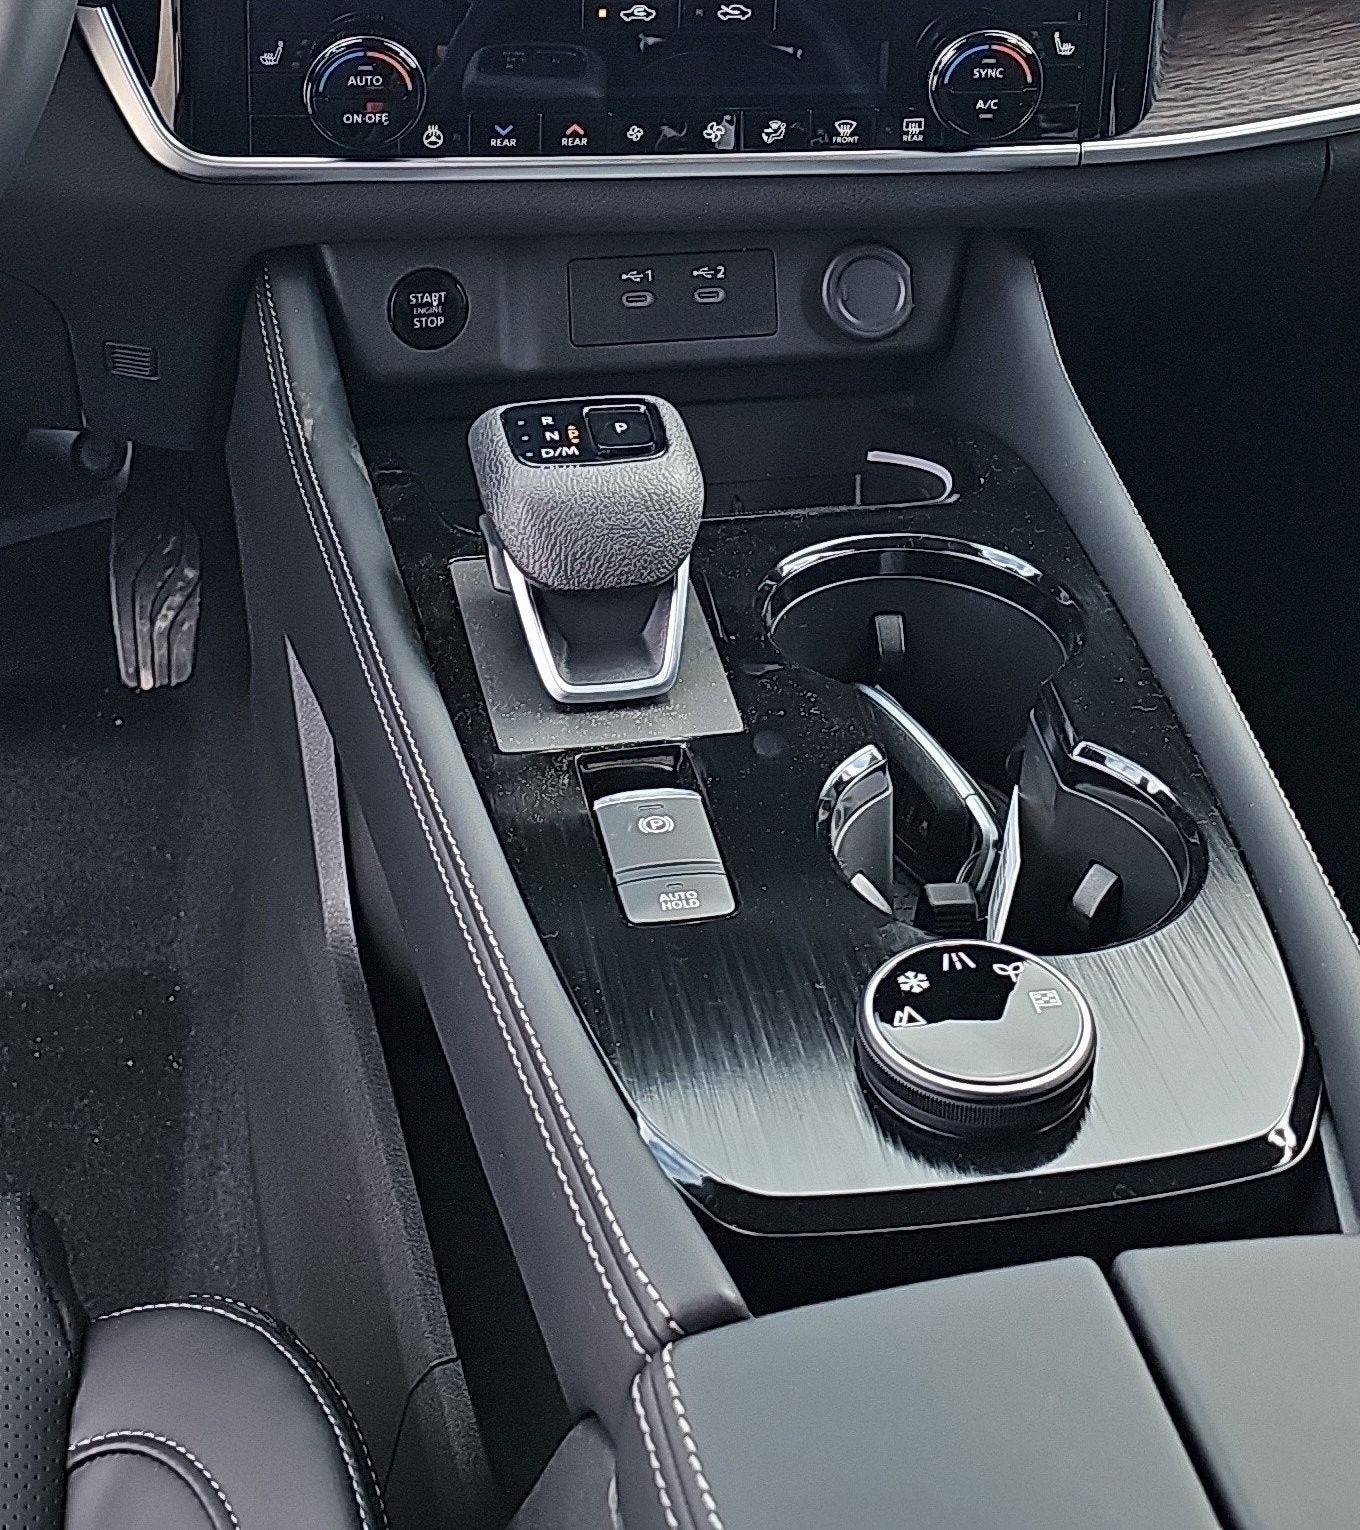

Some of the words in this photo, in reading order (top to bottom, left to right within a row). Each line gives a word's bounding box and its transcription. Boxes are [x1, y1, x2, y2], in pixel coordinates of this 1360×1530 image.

[972, 68, 1004, 78] SYNC
[347, 75, 383, 86] AUTO
[976, 99, 999, 110] A/C
[490, 138, 517, 147] REAR
[561, 137, 588, 146] REAR
[832, 136, 859, 144] FRONT
[902, 134, 924, 142] REAR
[646, 269, 654, 282] 1
[716, 266, 725, 279] 2
[409, 291, 447, 304] START
[413, 316, 445, 329] STOP
[541, 416, 554, 425] R
[615, 422, 628, 433] P
[544, 431, 559, 441] N
[541, 446, 579, 458] D/M
[660, 891, 698, 902] AUTO
[662, 899, 700, 910] HOLD
